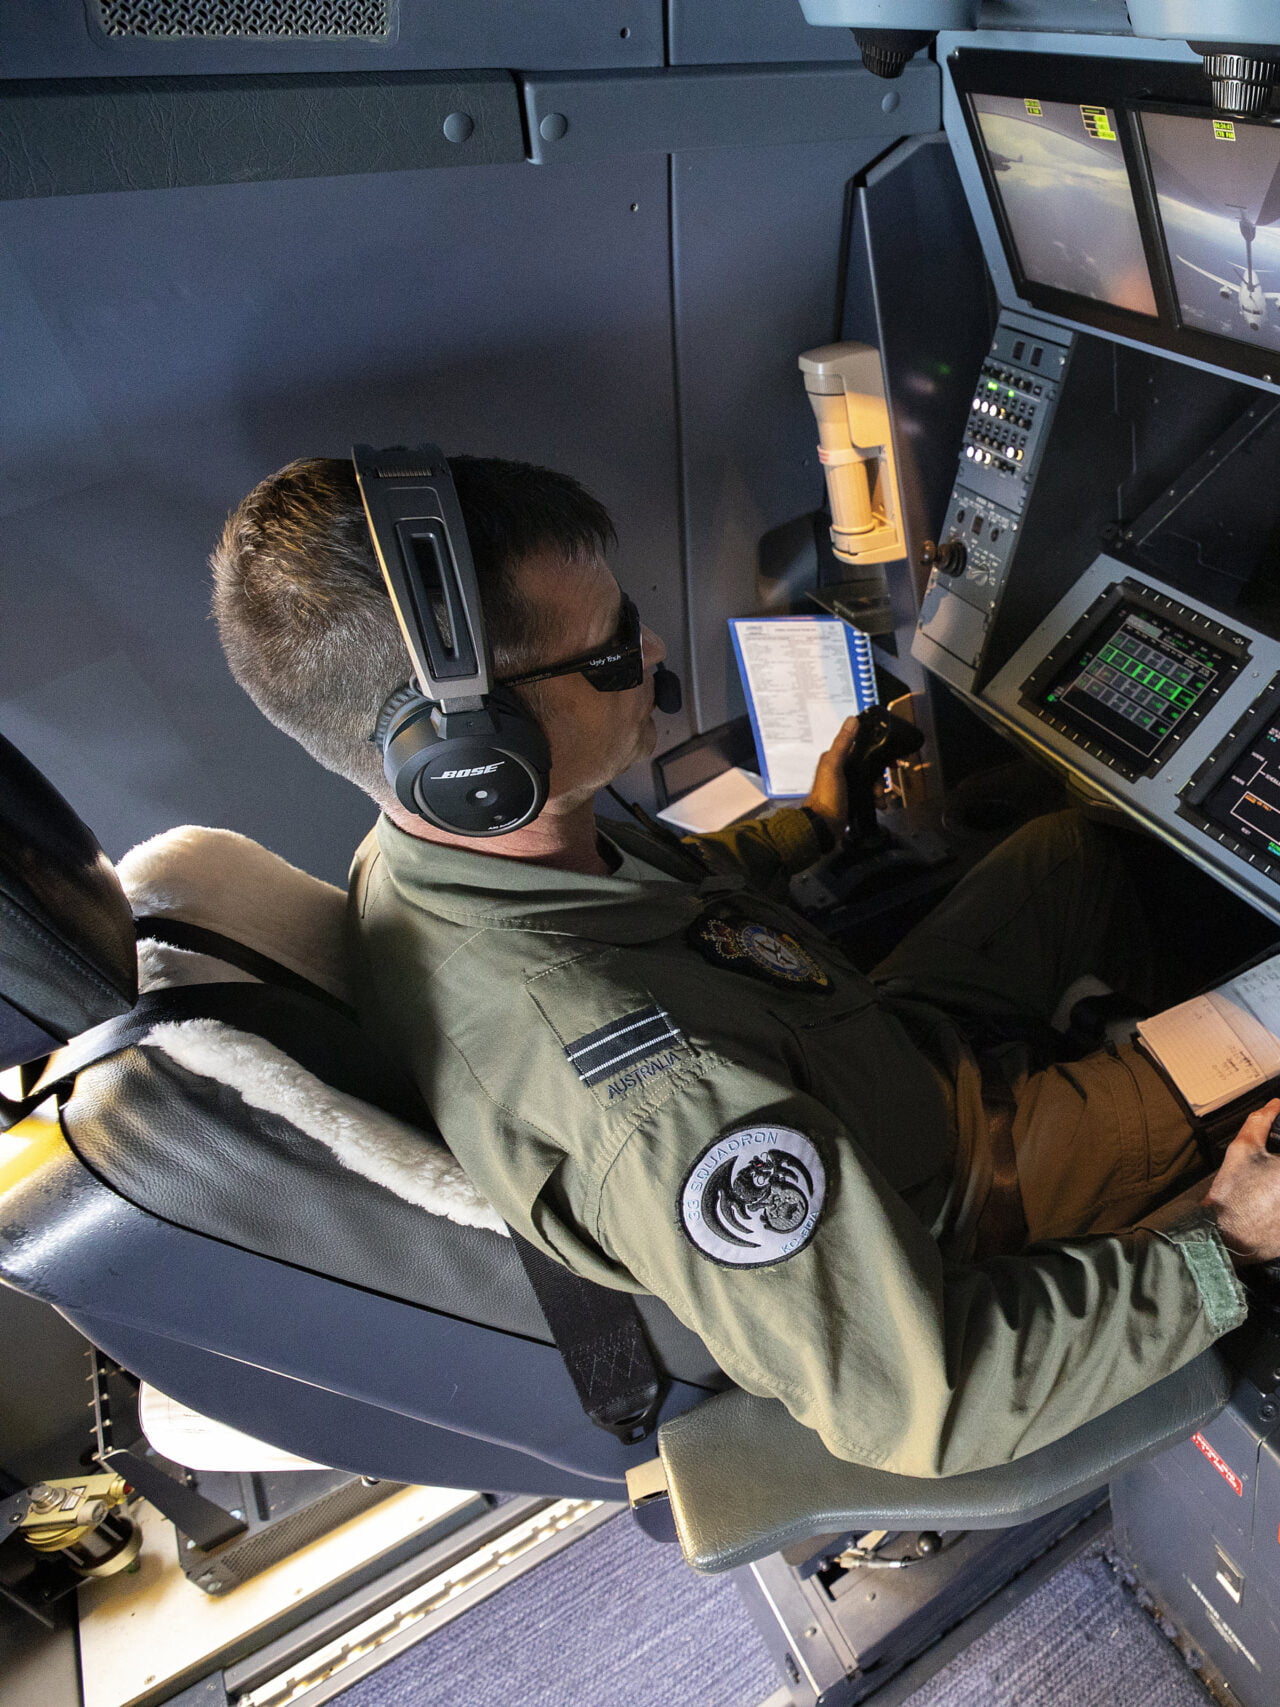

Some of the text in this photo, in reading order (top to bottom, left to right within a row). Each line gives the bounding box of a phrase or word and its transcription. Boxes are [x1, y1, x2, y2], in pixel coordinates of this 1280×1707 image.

[589, 659, 606, 667] Ugly
[436, 762, 502, 780] BOSE
[606, 1050, 681, 1100] AUSTRALIA
[687, 1131, 779, 1221] 33 SQUADRON
